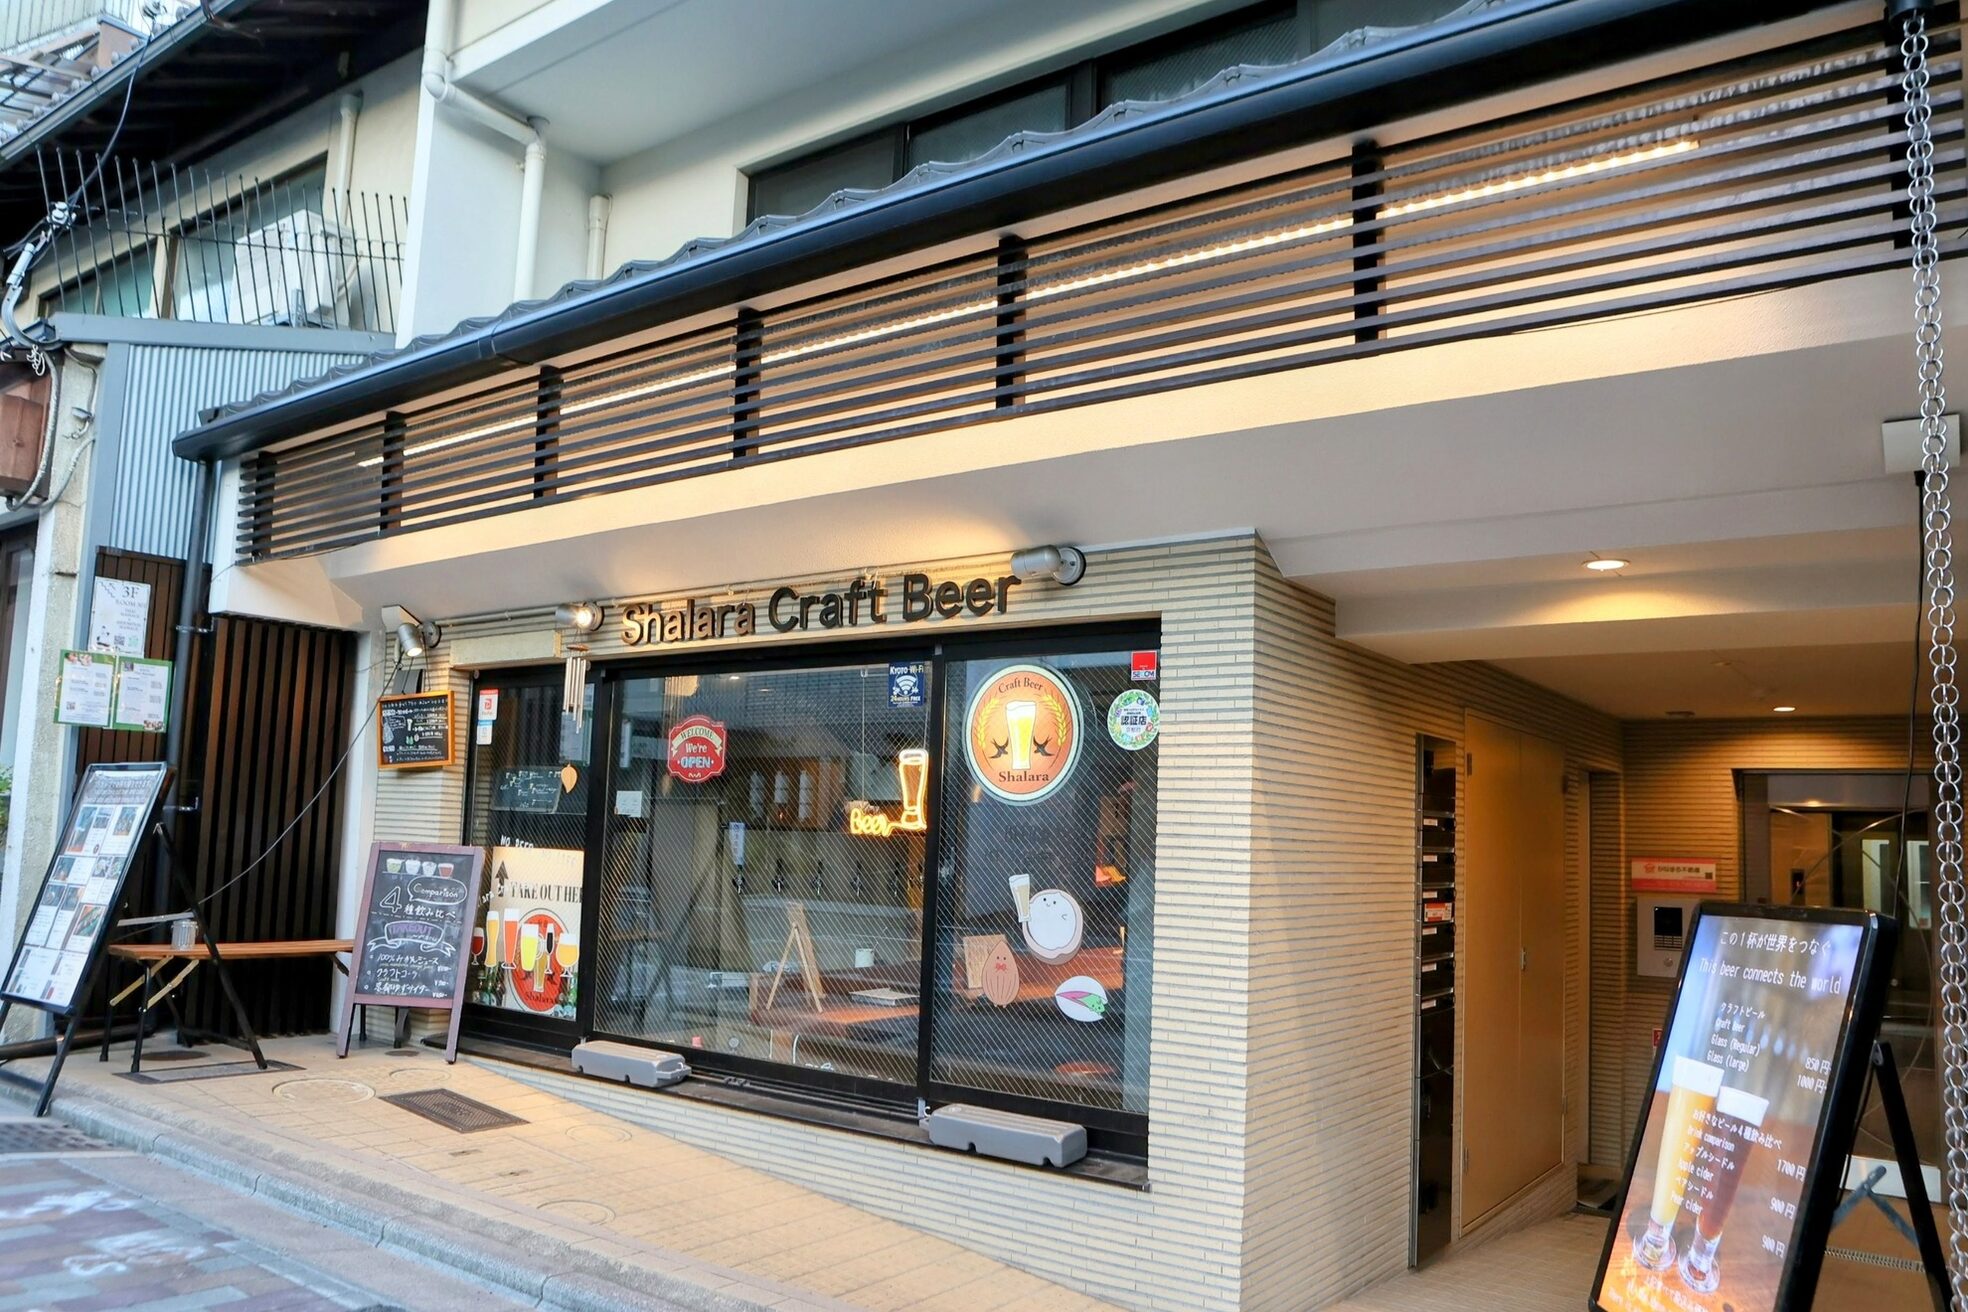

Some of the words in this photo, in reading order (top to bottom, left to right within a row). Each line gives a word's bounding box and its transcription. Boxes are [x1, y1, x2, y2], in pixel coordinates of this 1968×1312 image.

[122, 586, 139, 599] 3F
[620, 599, 756, 646] Shalara
[768, 578, 888, 633] Craft
[902, 572, 1022, 623] Beer
[998, 677, 1022, 693] Craft
[1023, 677, 1044, 691] Beer
[1121, 716, 1147, 726] 認証店
[680, 727, 714, 739] WELCOME
[685, 743, 708, 753] We're
[680, 756, 712, 768] OPEN
[998, 770, 1050, 782] Shalara
[850, 807, 893, 838] Beer
[500, 835, 511, 847] NO
[413, 882, 458, 899] Comparison
[511, 881, 538, 900] TAKE
[540, 884, 563, 902] OUT
[1699, 958, 1717, 974] This
[1719, 960, 1741, 978] beer
[1742, 967, 1785, 985] connects
[1789, 971, 1807, 988] the
[1811, 975, 1842, 995] world
[1720, 1002, 1766, 1019] クラフトビール
[1710, 1033, 1728, 1048] Glass
[1706, 1049, 1724, 1065] Glass
[1703, 1133, 1736, 1153] comparison
[1695, 1165, 1714, 1182] cider
[1685, 1199, 1704, 1216] cider
[1769, 1196, 1796, 1220] 900円
[1761, 1234, 1786, 1259] 900円
